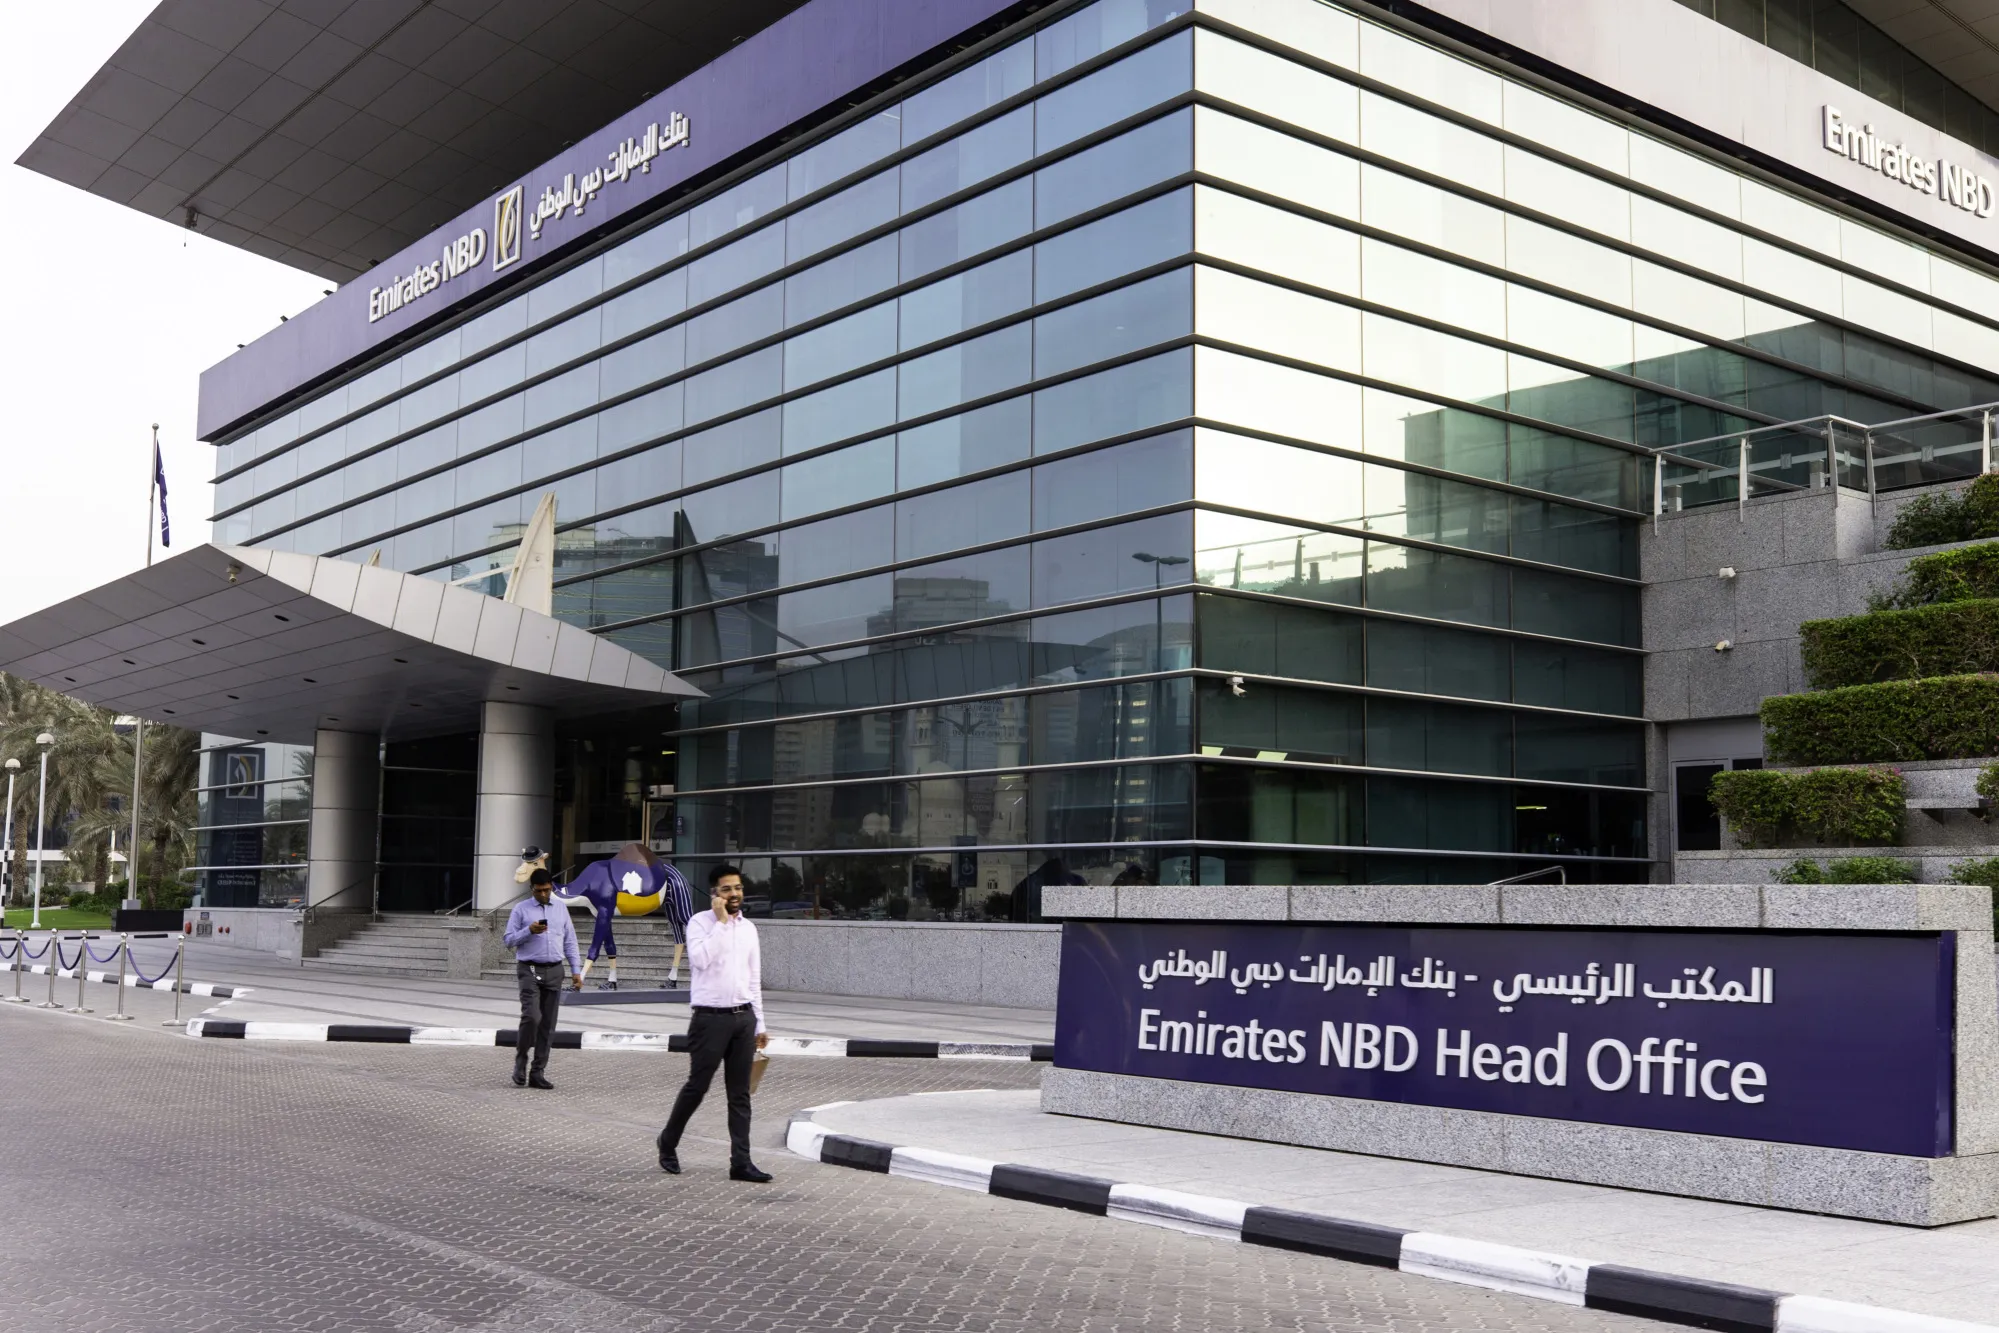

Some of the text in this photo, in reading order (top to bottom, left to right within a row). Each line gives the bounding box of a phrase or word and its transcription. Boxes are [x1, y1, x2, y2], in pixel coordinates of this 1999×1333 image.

[529, 111, 690, 240] بنك الإمارات دبي الوطني
[1822, 104, 1996, 218] Emirates NBD
[369, 227, 487, 323] Emirates NBD
[1138, 949, 1228, 990] الوطني
[1230, 961, 1285, 995] دبي
[1289, 953, 1395, 998] الإمارات
[1400, 956, 1456, 999] بنك
[1492, 962, 1636, 1014] الرئيسي
[1643, 965, 1773, 1009] المكتب
[1138, 1008, 1768, 1104] Emirates NBD Head Office
